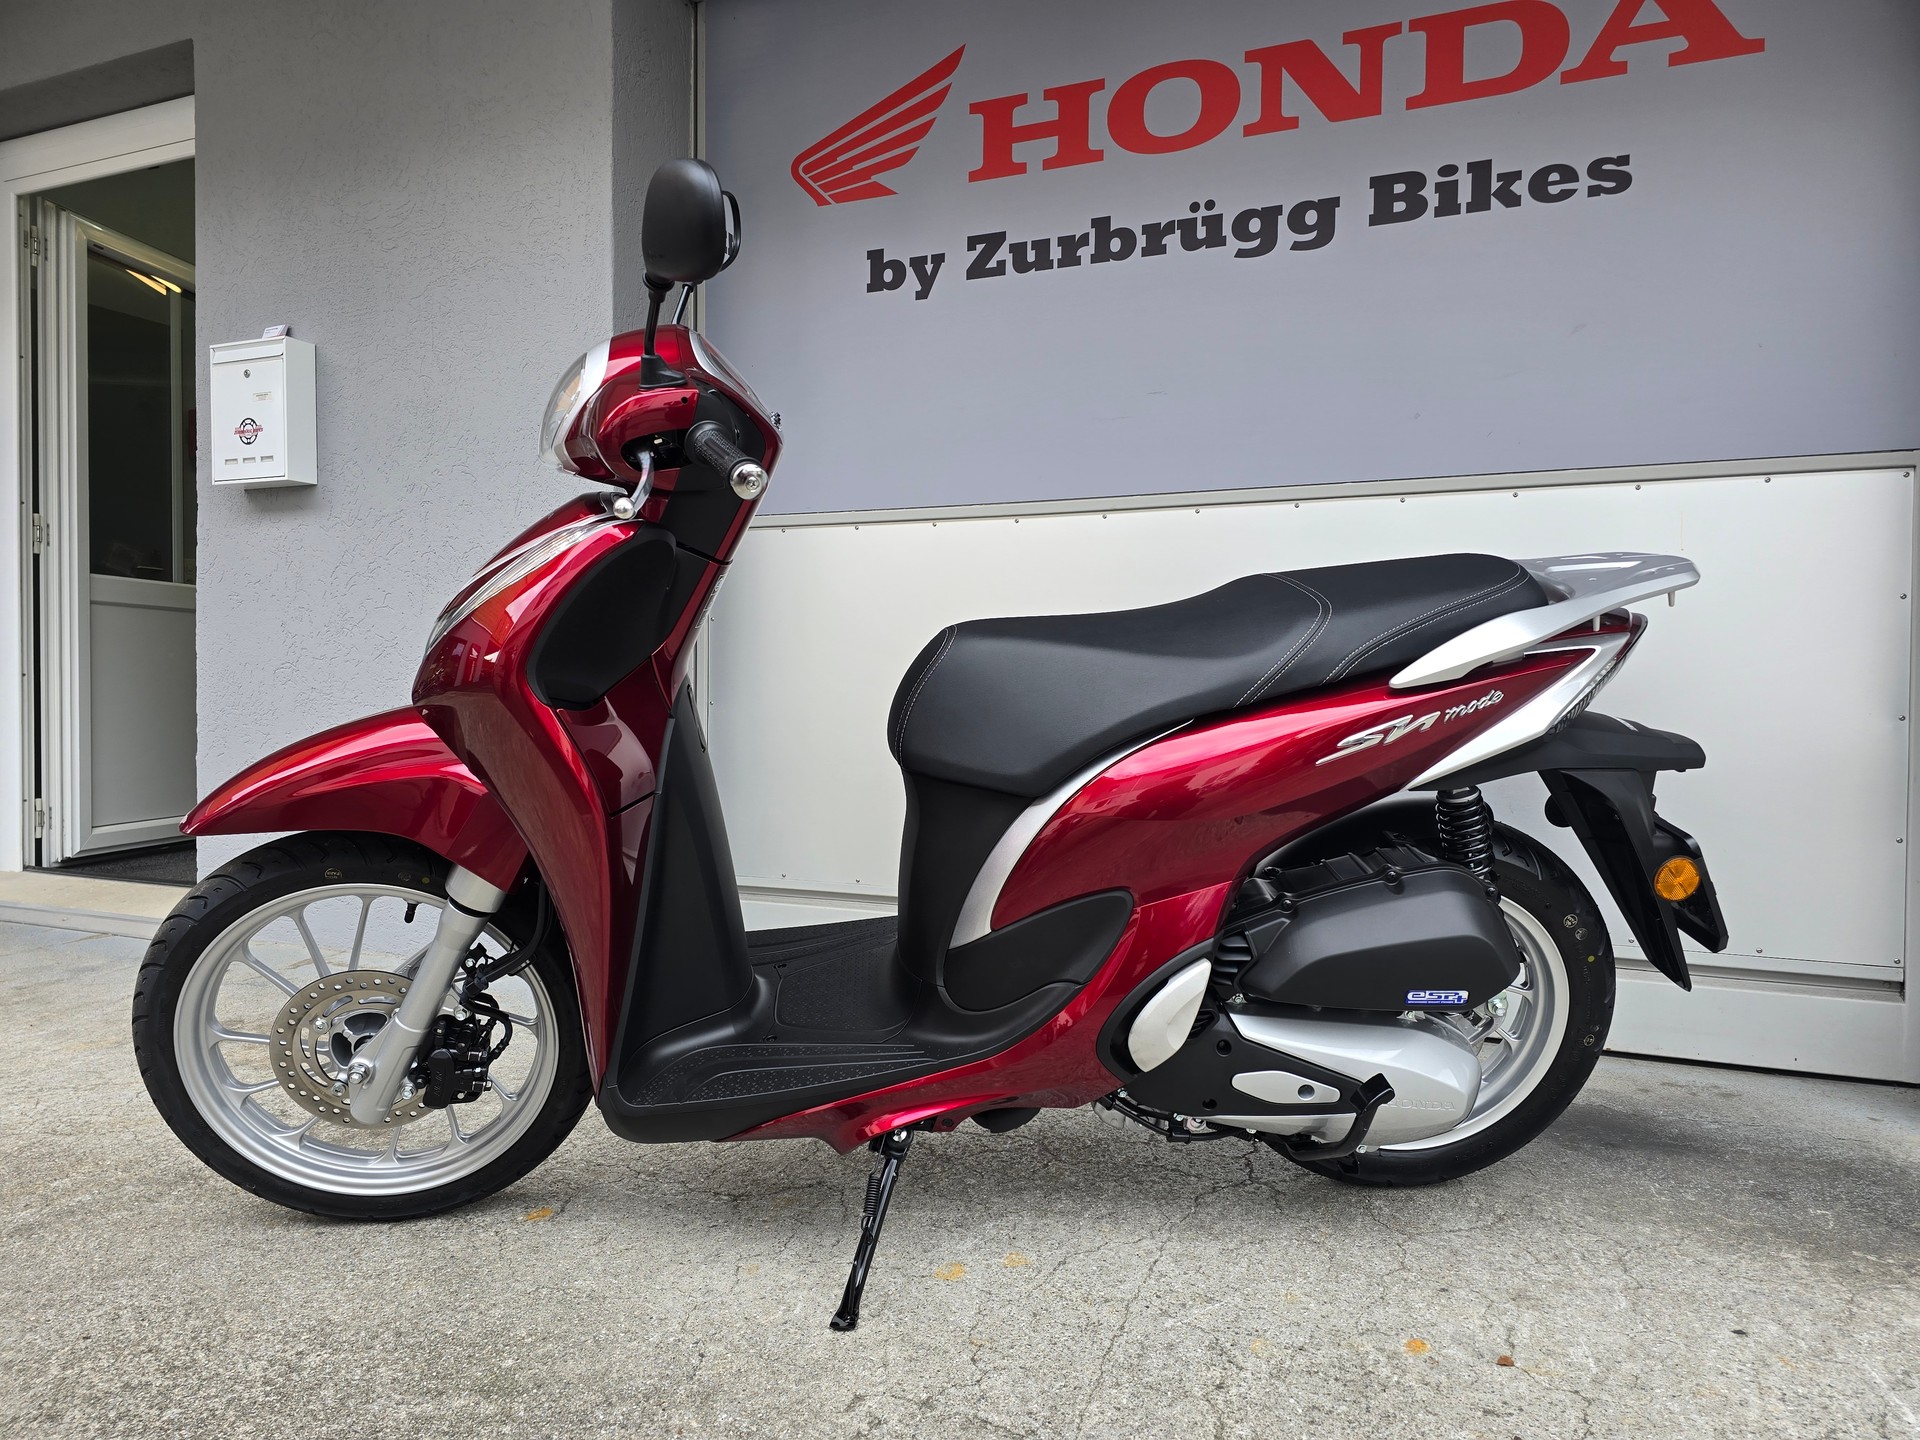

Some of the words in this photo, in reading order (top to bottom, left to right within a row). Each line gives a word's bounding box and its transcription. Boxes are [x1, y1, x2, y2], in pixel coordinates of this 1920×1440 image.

[969, 0, 1765, 182] HONDA
[866, 248, 946, 301] by
[966, 196, 1341, 281] Zurbrügg
[1368, 154, 1633, 227] Bikes
[1443, 690, 1505, 724] mode
